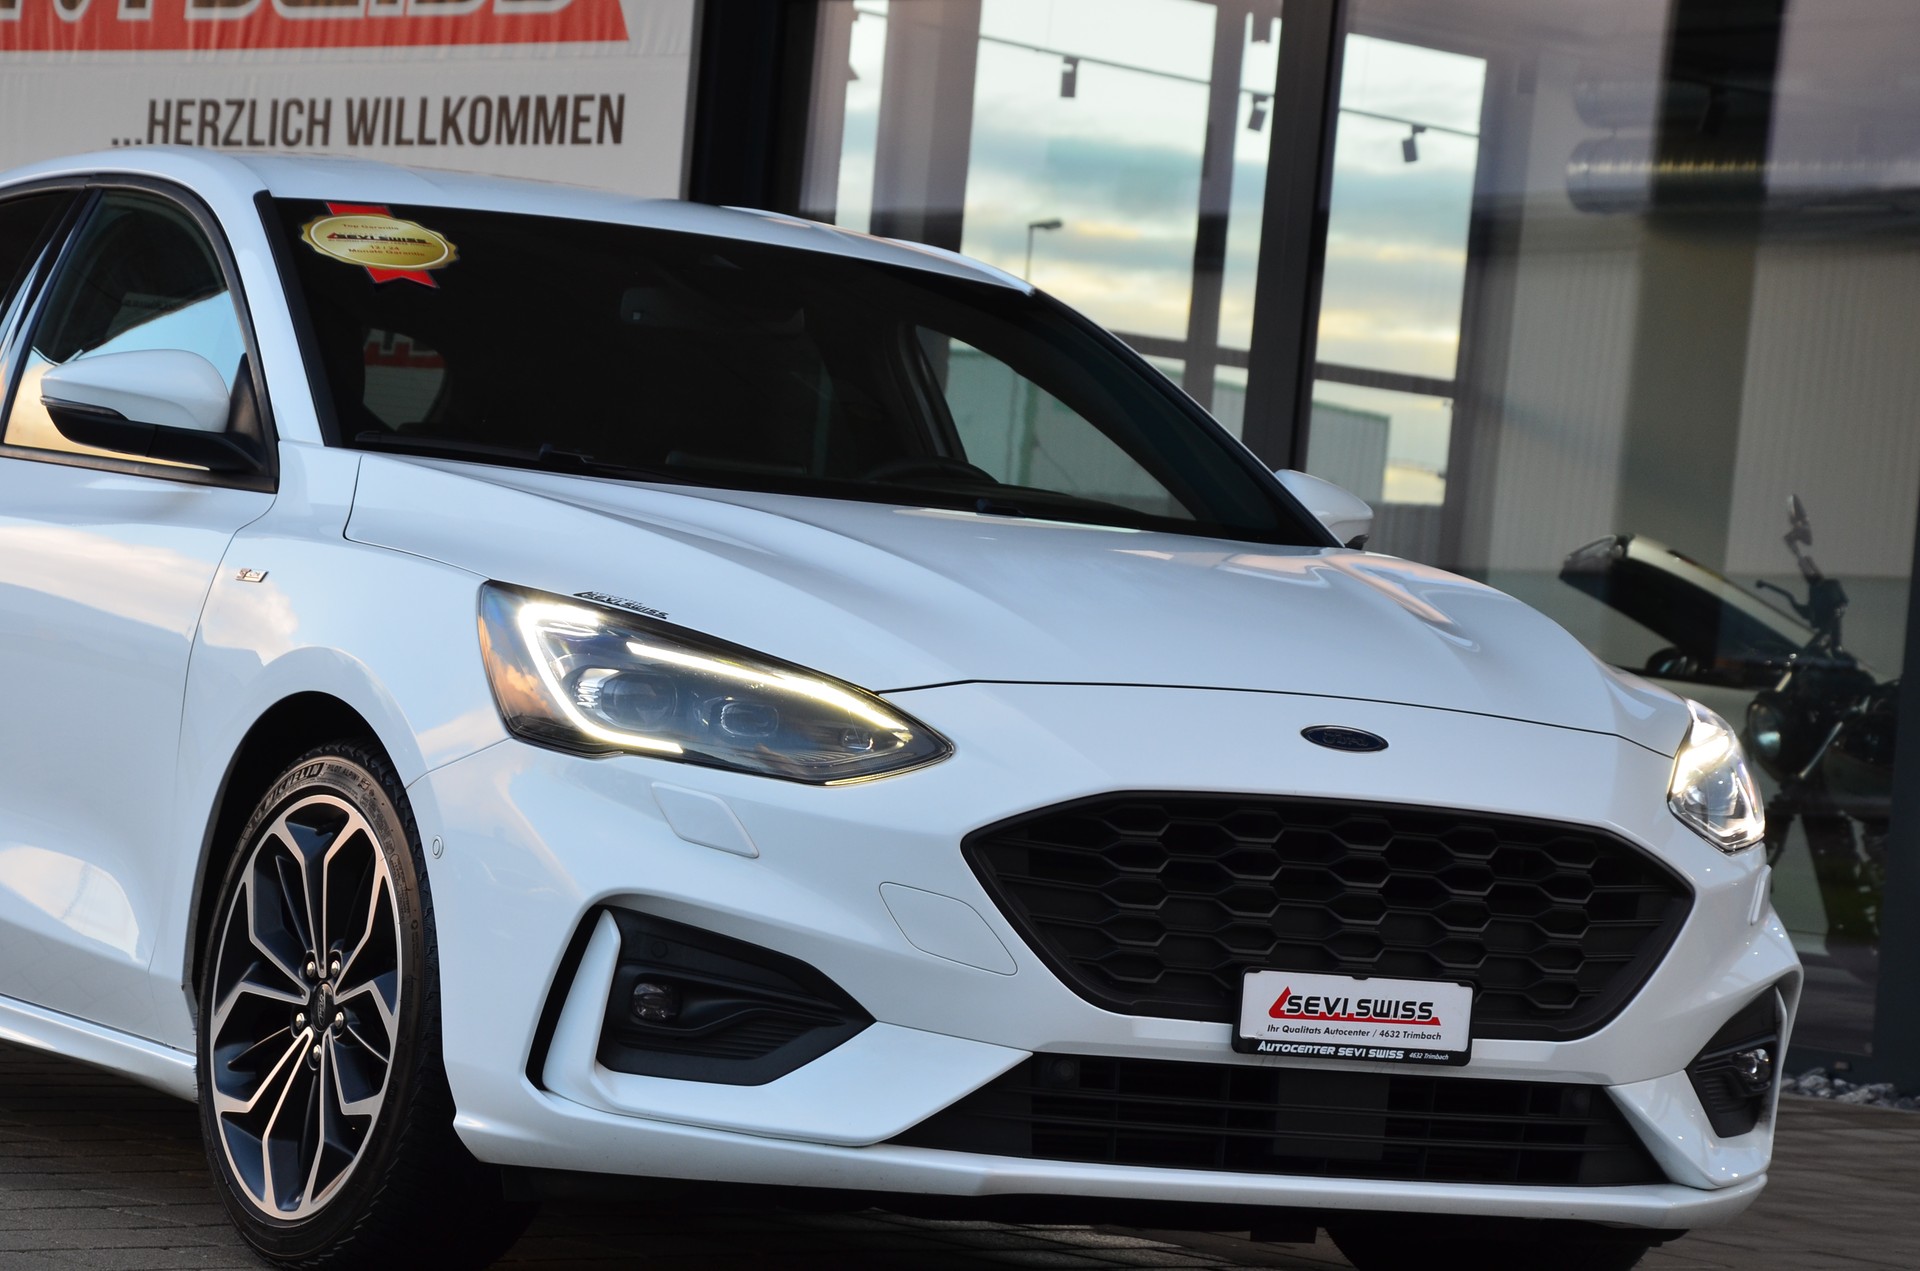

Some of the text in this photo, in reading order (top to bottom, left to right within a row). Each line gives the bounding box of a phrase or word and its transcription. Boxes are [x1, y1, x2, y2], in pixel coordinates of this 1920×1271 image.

[346, 94, 626, 146] WILLKOMMEN
[378, 235, 428, 244] SWISS
[1285, 995, 1434, 1020] SEVI SWISS
[1267, 1024, 1279, 1033] Ihr
[1281, 1025, 1322, 1036] Qualitats
[1323, 1026, 1371, 1038] Autocenter
[1379, 1029, 1401, 1039] 4632
[1402, 1030, 1442, 1041] Trimbach
[1257, 1040, 1449, 1061] AUTOCENTER SEVI SWISS 4632 Trimbach
